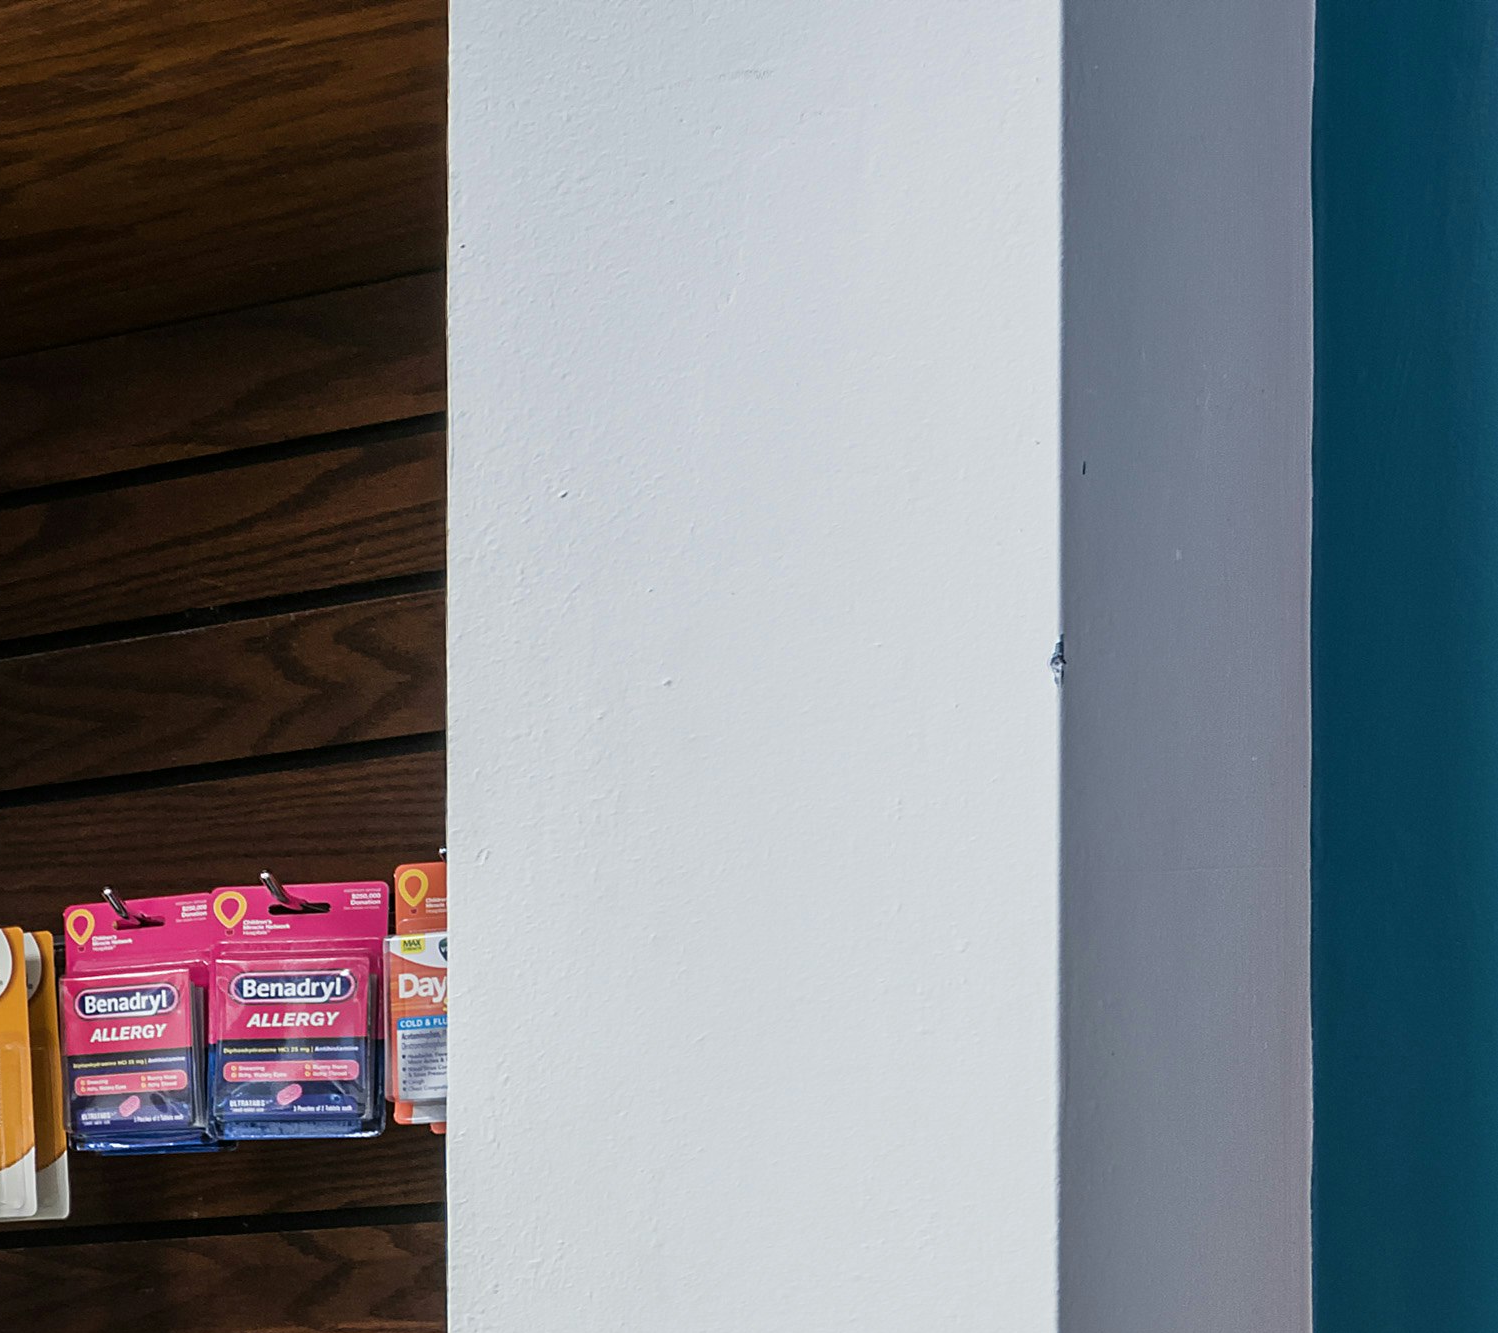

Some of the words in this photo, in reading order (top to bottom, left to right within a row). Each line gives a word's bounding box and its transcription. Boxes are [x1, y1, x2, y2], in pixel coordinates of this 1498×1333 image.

[402, 939, 422, 948] MAX
[242, 978, 342, 1003] Benadryl
[85, 989, 168, 1016] Benadryl
[246, 1011, 341, 1028] ALLERGY
[399, 1018, 423, 1028] COLD
[424, 1018, 432, 1027] &
[90, 1023, 168, 1043] ALLERGY
